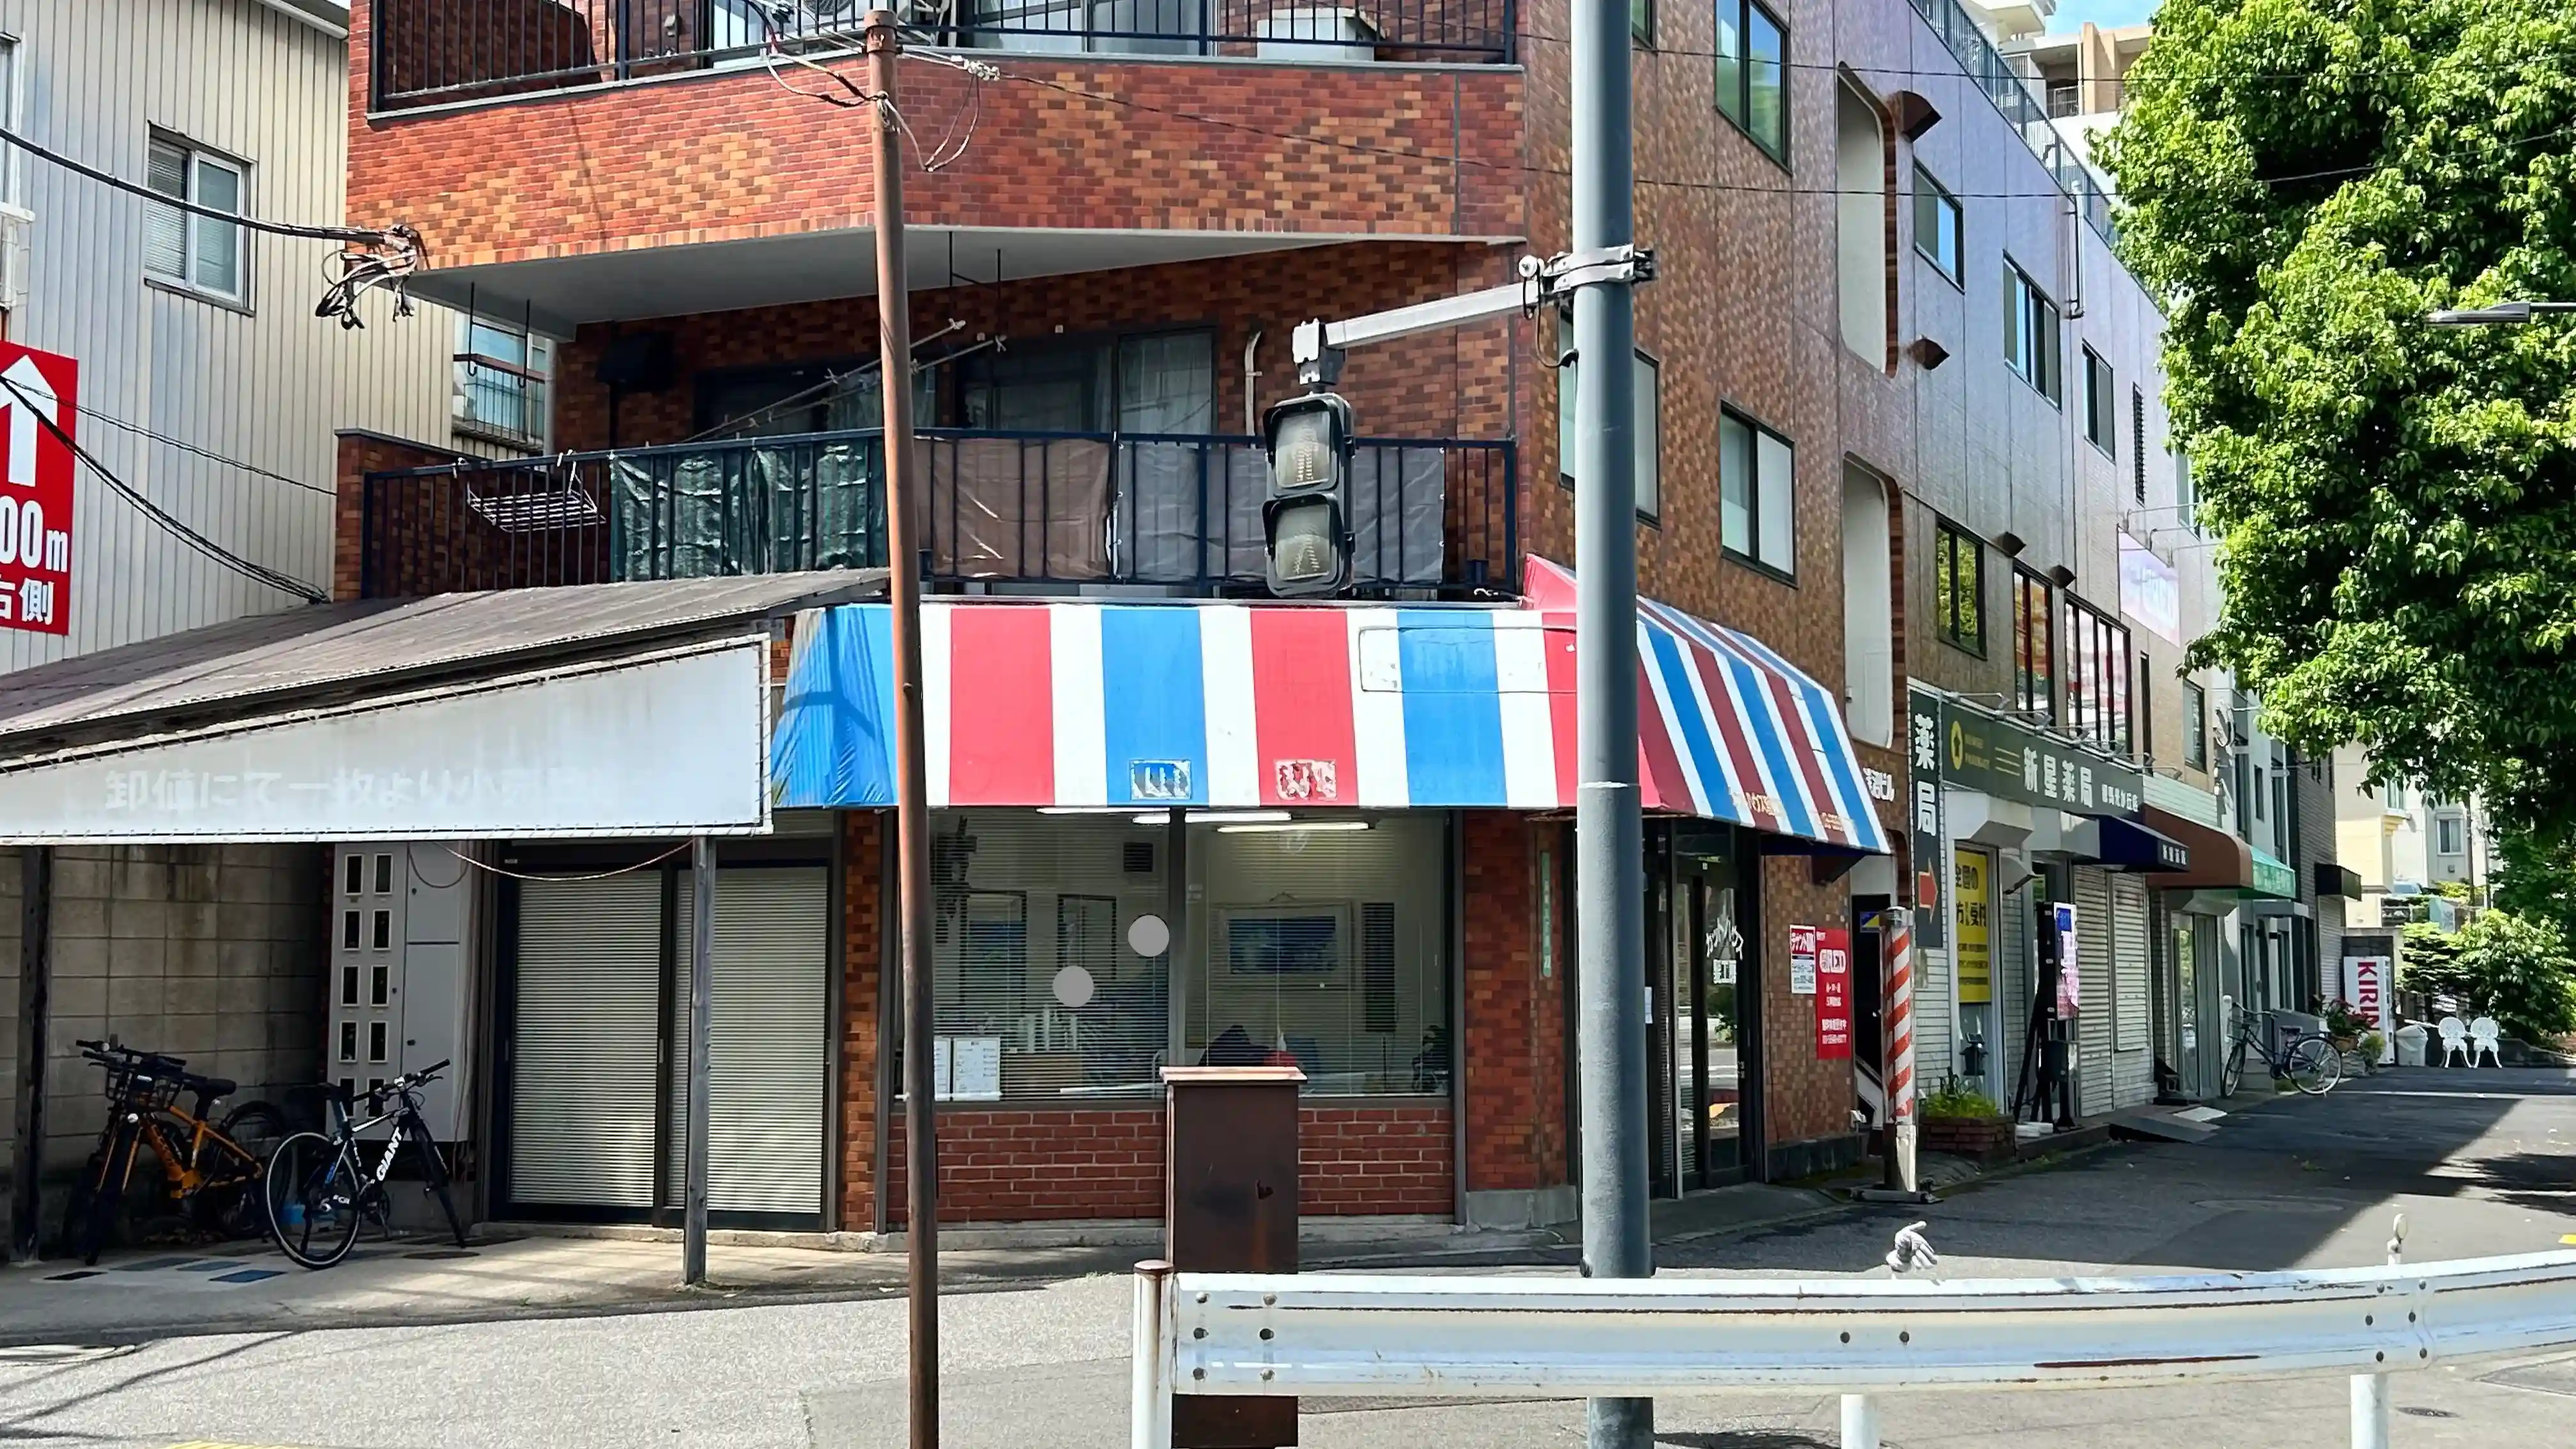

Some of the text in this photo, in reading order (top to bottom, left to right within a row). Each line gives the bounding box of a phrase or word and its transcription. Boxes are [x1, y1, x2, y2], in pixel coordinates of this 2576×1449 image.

[1915, 713, 1936, 836] 薬局
[2023, 746, 2093, 808] 新星薬局
[376, 1126, 402, 1181] GIANT
